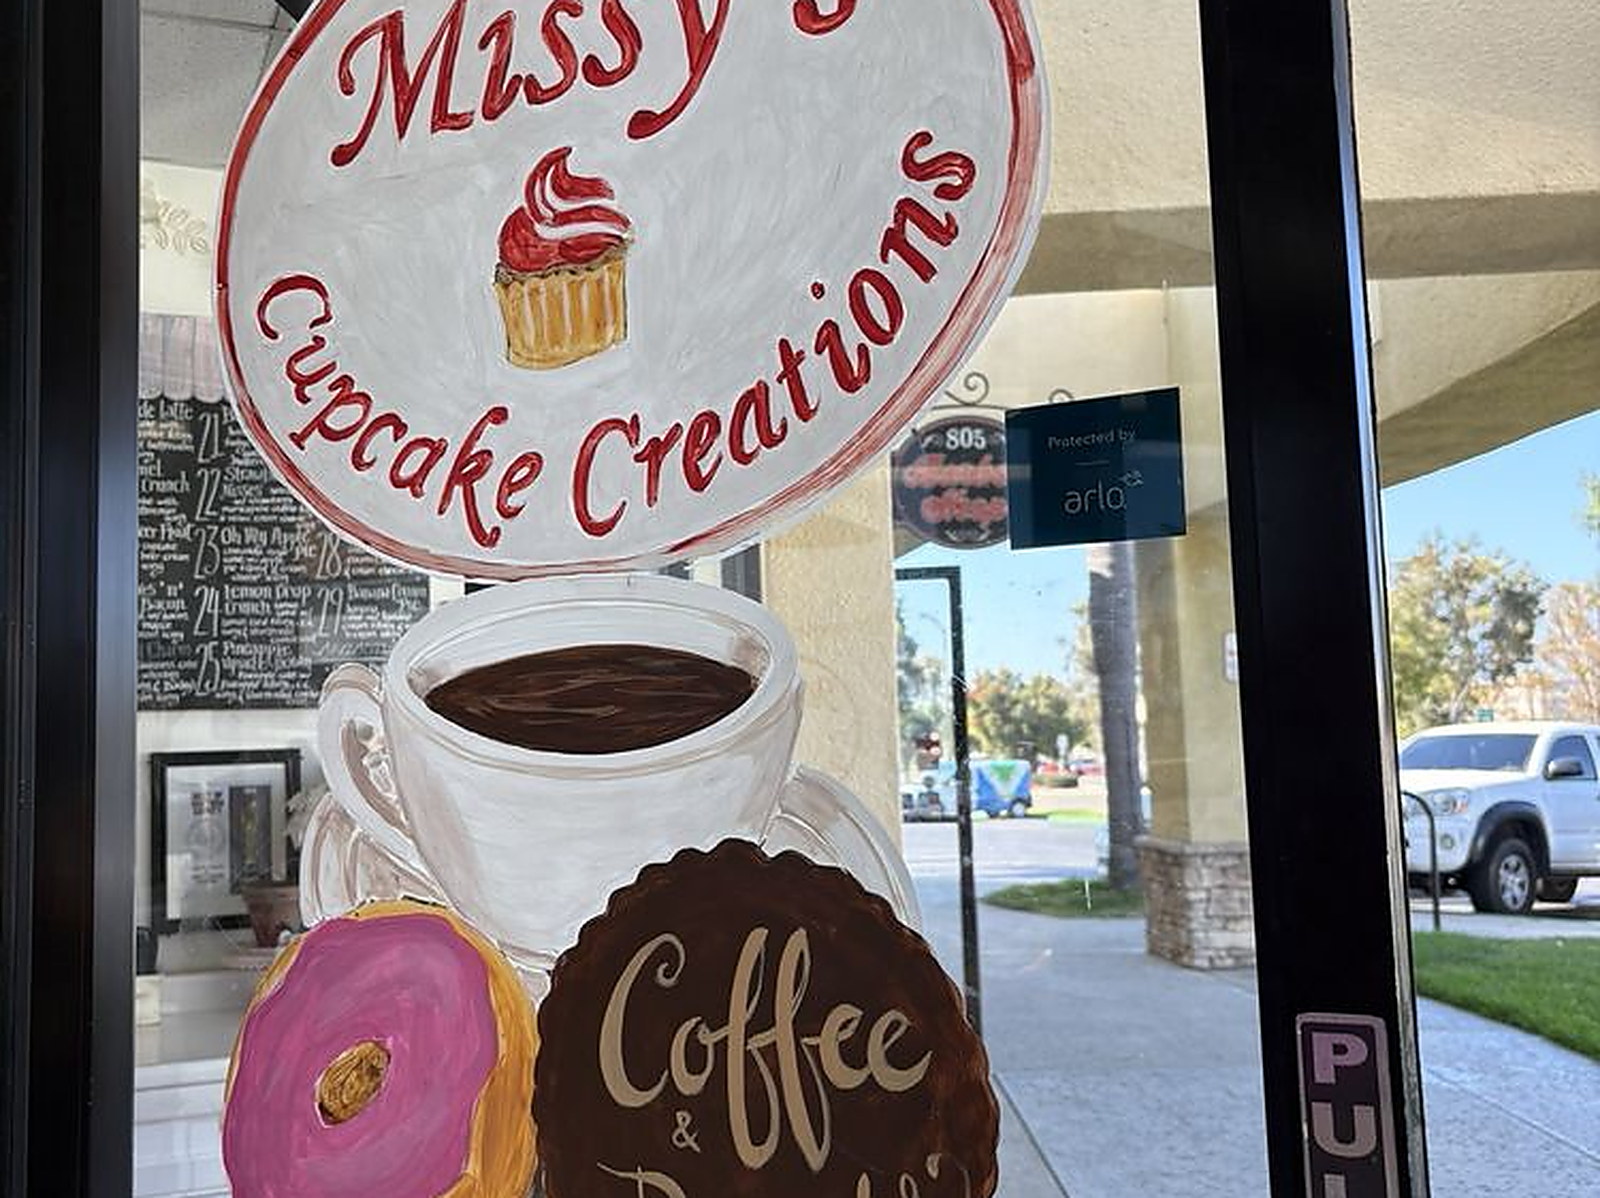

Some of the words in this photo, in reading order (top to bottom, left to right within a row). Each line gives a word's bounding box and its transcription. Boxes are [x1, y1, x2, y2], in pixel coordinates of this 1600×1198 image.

[256, 274, 543, 548] Cupcake
[573, 130, 978, 536] Creations
[198, 412, 225, 463] 21
[946, 426, 986, 449] 805
[1048, 429, 1115, 449] Protected
[1119, 427, 1136, 442] by
[141, 470, 191, 493] Crunch
[196, 468, 221, 521] 22
[1064, 479, 1126, 514] arlo
[194, 525, 222, 577] 23
[221, 526, 242, 545] Oh
[316, 533, 343, 580] 28
[193, 585, 222, 637] 24
[224, 583, 272, 600] Lemon
[276, 583, 312, 606] Drop
[224, 600, 271, 616] Crunch
[316, 587, 344, 637] 29
[195, 640, 222, 697] 25
[600, 926, 932, 1172] Coffee
[671, 1111, 701, 1152] &
